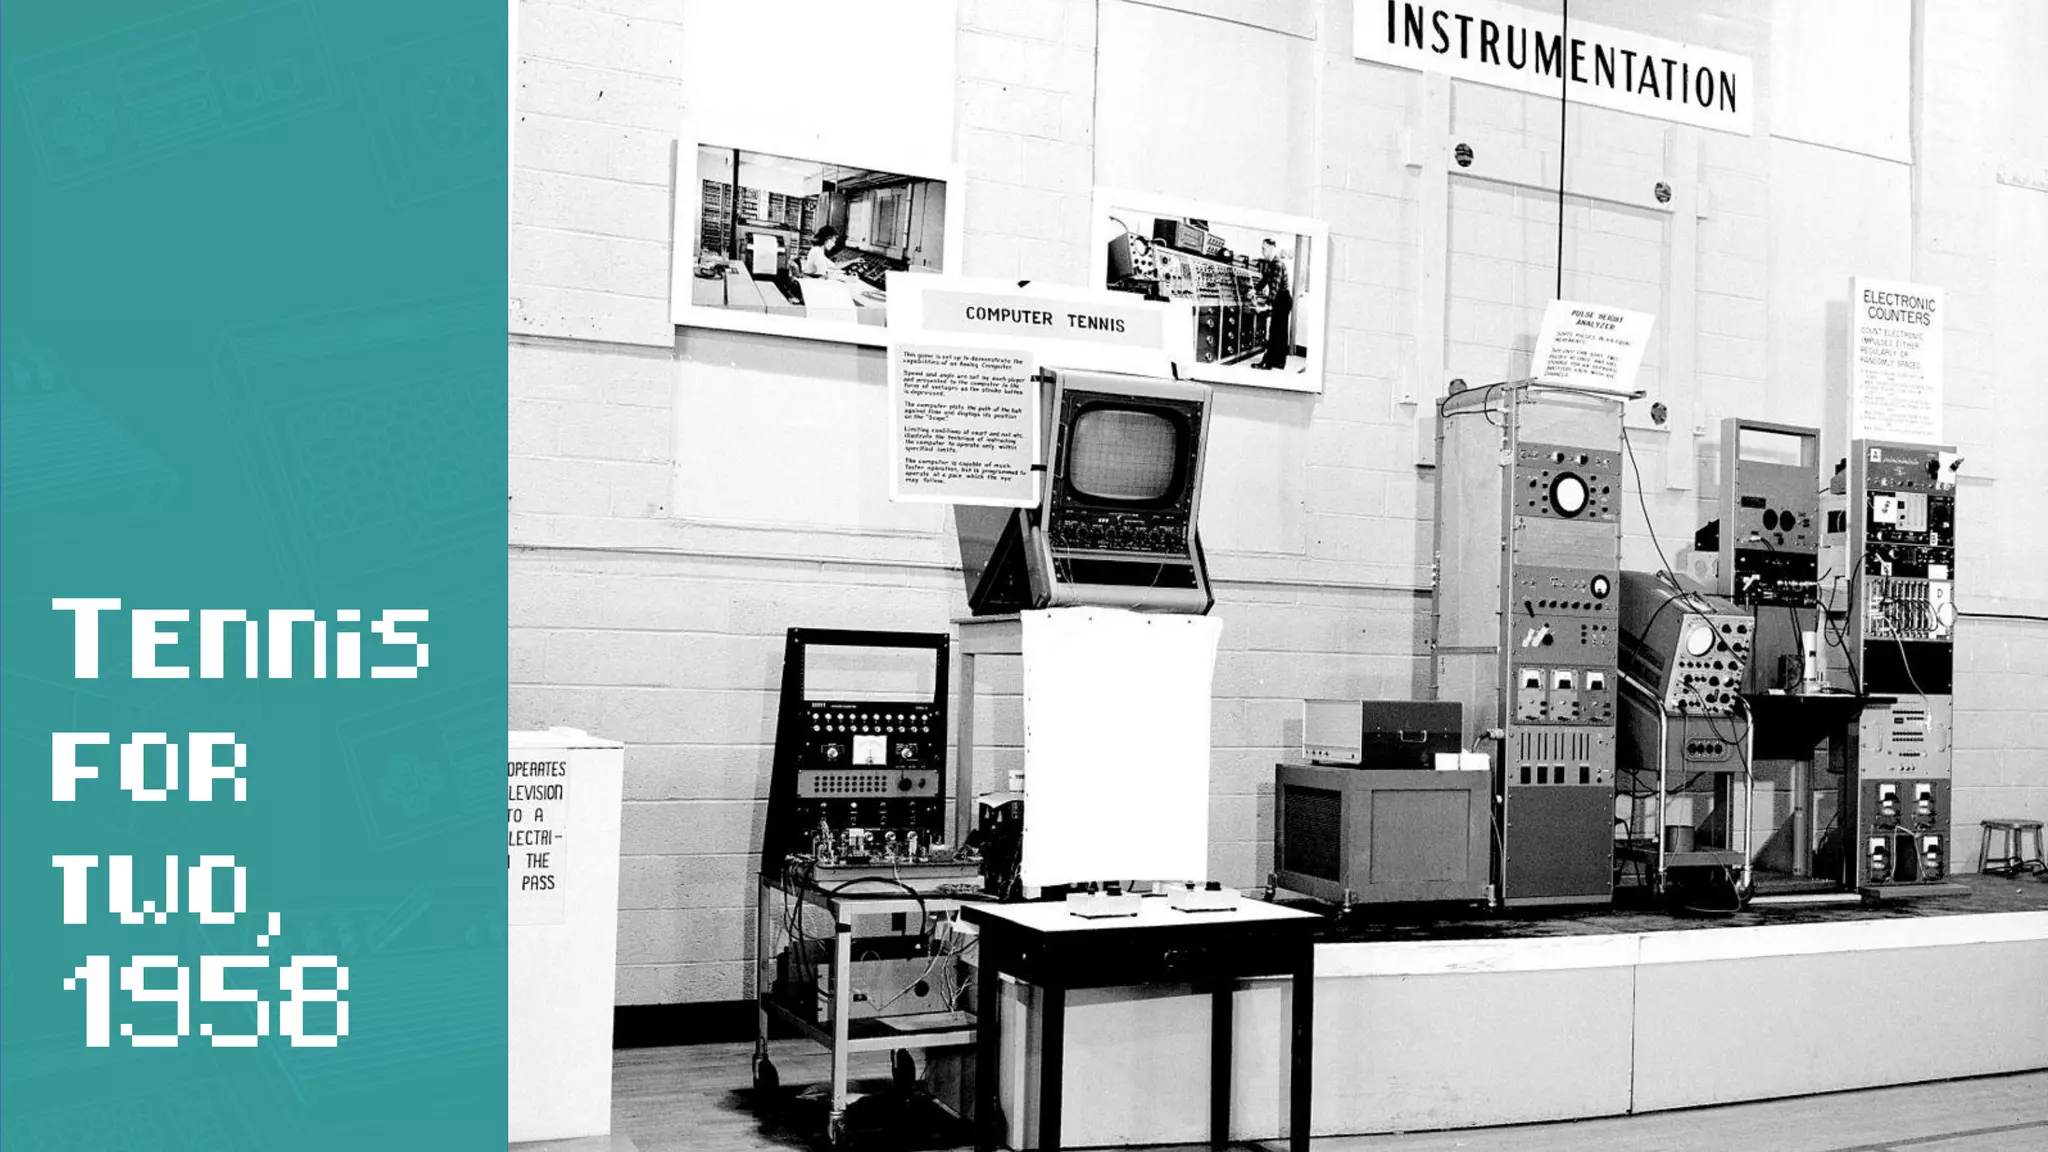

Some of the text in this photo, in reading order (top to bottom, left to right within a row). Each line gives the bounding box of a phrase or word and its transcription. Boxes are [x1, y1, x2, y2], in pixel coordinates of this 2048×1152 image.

[1388, 0, 1736, 113] INSTRUMENTATION
[1864, 289, 1936, 312] ELECTRONIC
[966, 306, 1125, 332] COMPUTER TENNIS
[1572, 310, 1594, 318] PULSE
[1868, 306, 1930, 326] COUNTERS
[1576, 319, 1615, 330] ANALYZER
[508, 761, 566, 777] OPERATES
[535, 808, 543, 822] A
[526, 852, 550, 868] THE
[522, 875, 555, 890] PASS
